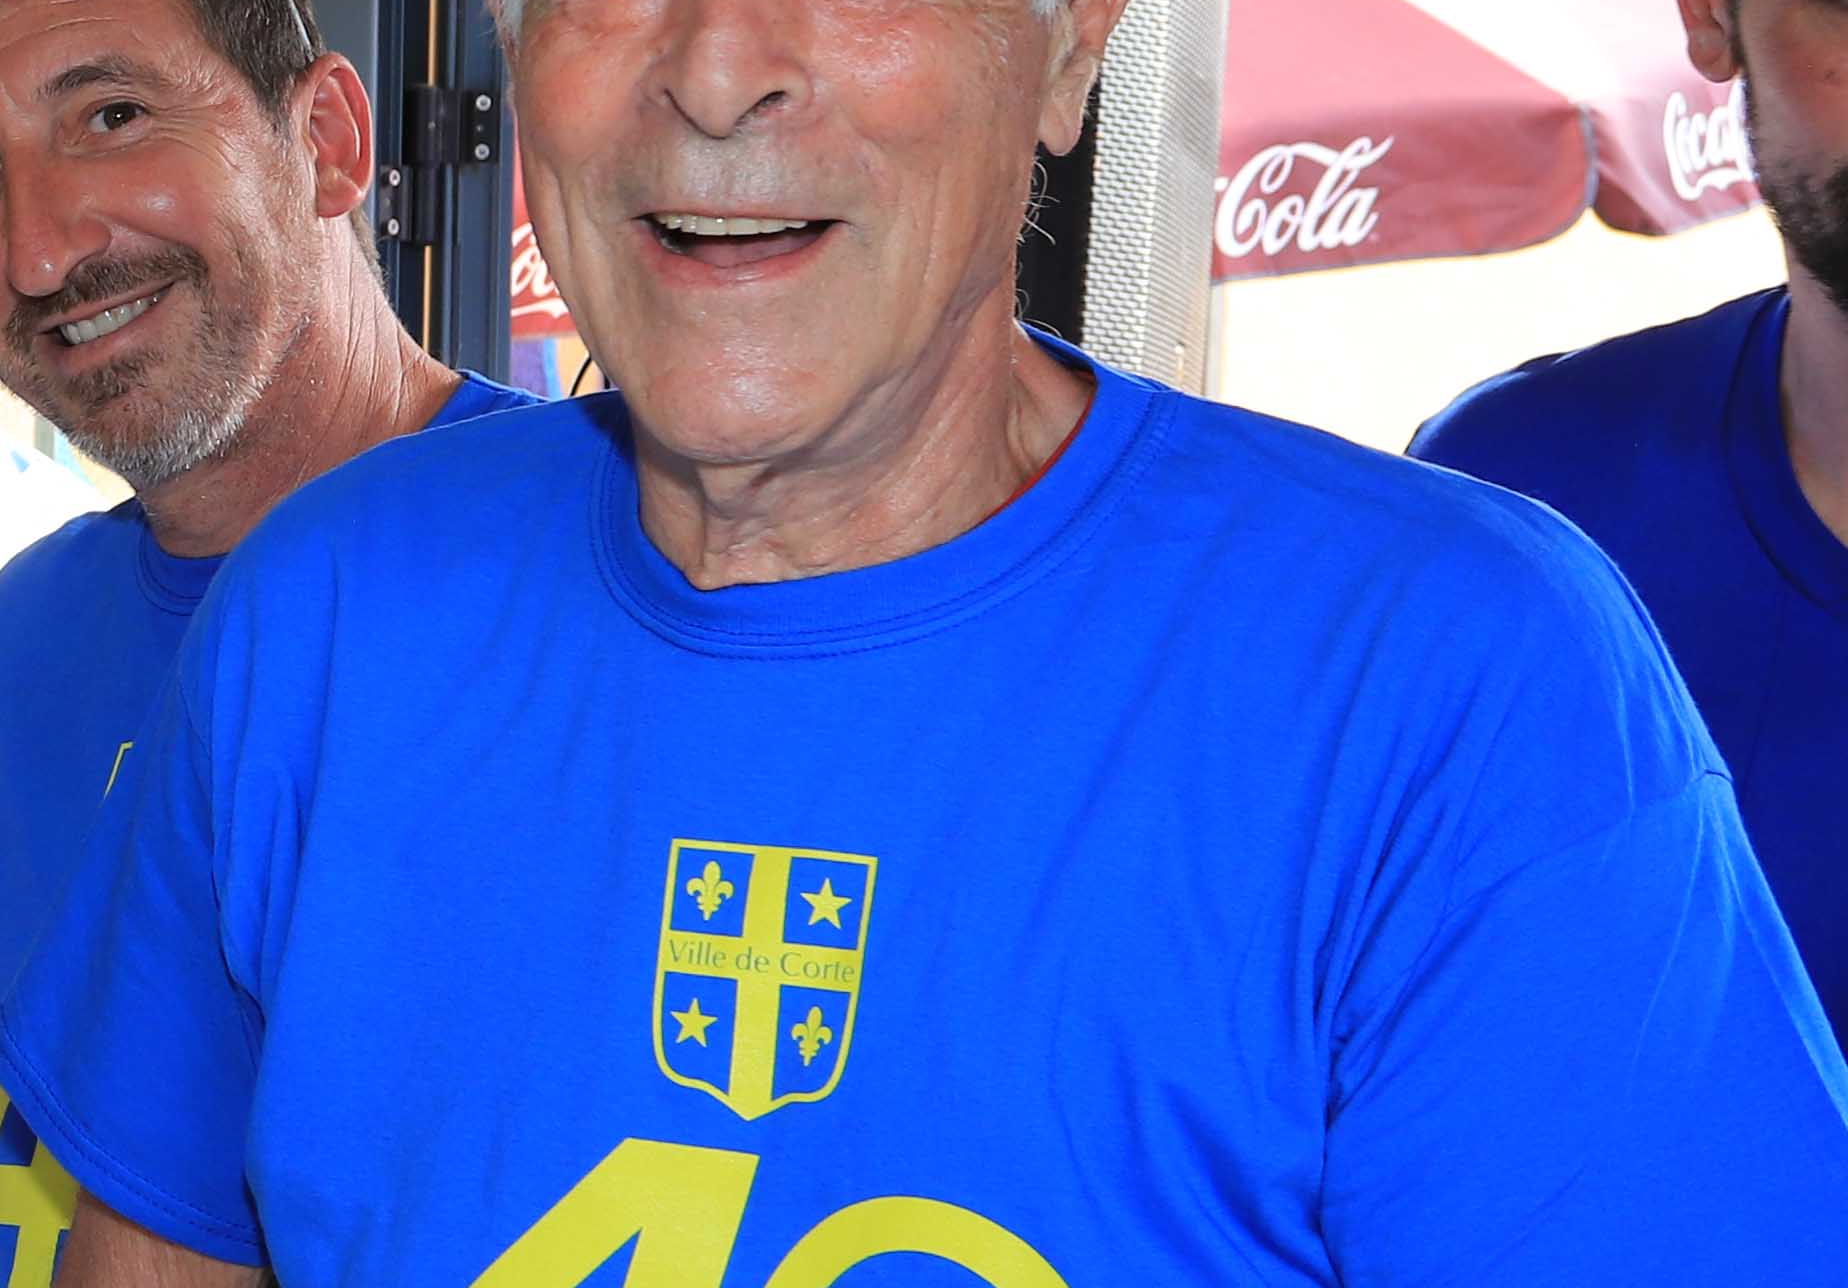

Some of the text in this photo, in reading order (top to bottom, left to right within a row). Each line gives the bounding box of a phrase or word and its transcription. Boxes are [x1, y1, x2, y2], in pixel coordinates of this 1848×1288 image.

[669, 939, 856, 983] Ville de Corte
